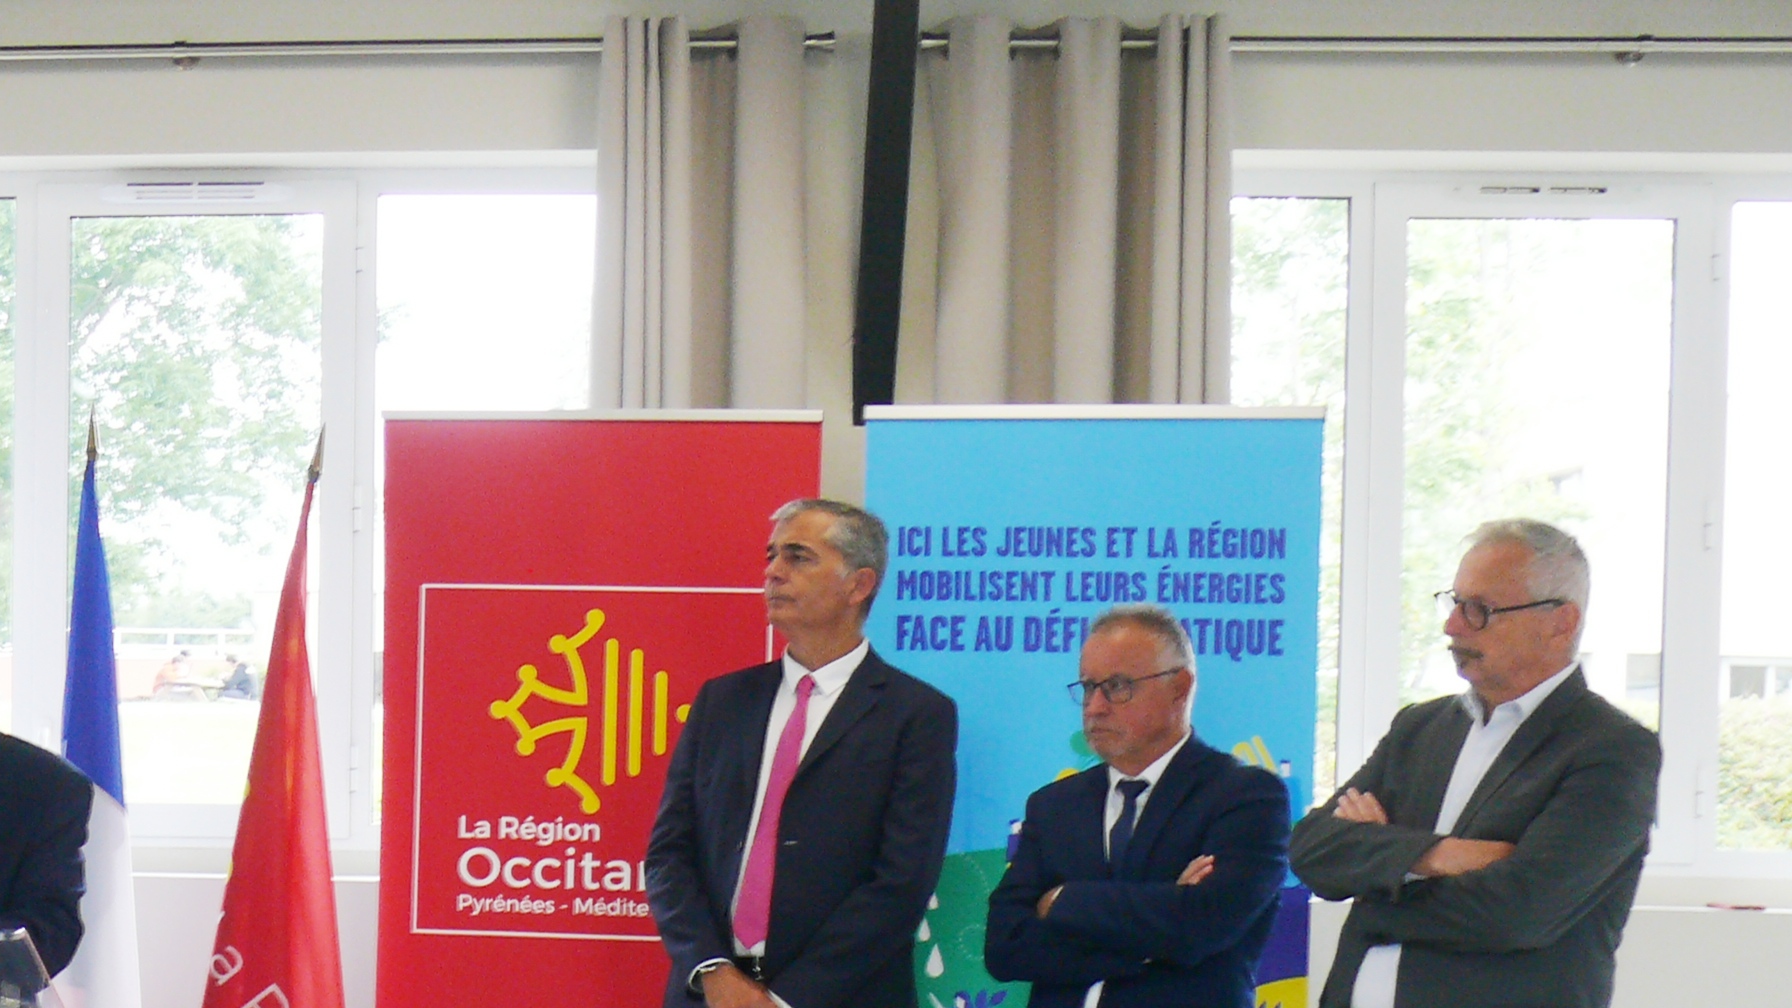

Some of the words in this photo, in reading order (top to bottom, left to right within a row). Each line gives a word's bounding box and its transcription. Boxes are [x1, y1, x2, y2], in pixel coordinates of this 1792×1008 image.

[897, 526, 932, 557] ICI
[942, 526, 987, 557] LES
[996, 526, 1097, 558] JEUNES
[1106, 526, 1138, 558] ET
[1147, 527, 1178, 558] LA
[1188, 520, 1286, 559] RÉGION
[896, 570, 1056, 601] MOBILISENT
[1065, 571, 1147, 602] LEURS
[1157, 564, 1286, 604] ÉNERGIES
[896, 614, 966, 651] FACE
[974, 616, 1013, 652] AU
[1023, 608, 1089, 653] DÉFI
[1181, 617, 1284, 661] TIQUE
[458, 815, 491, 839] La
[498, 816, 601, 846] Région
[458, 847, 646, 892] Occita
[456, 893, 556, 916] Pyrénées
[573, 896, 650, 918] Médite
